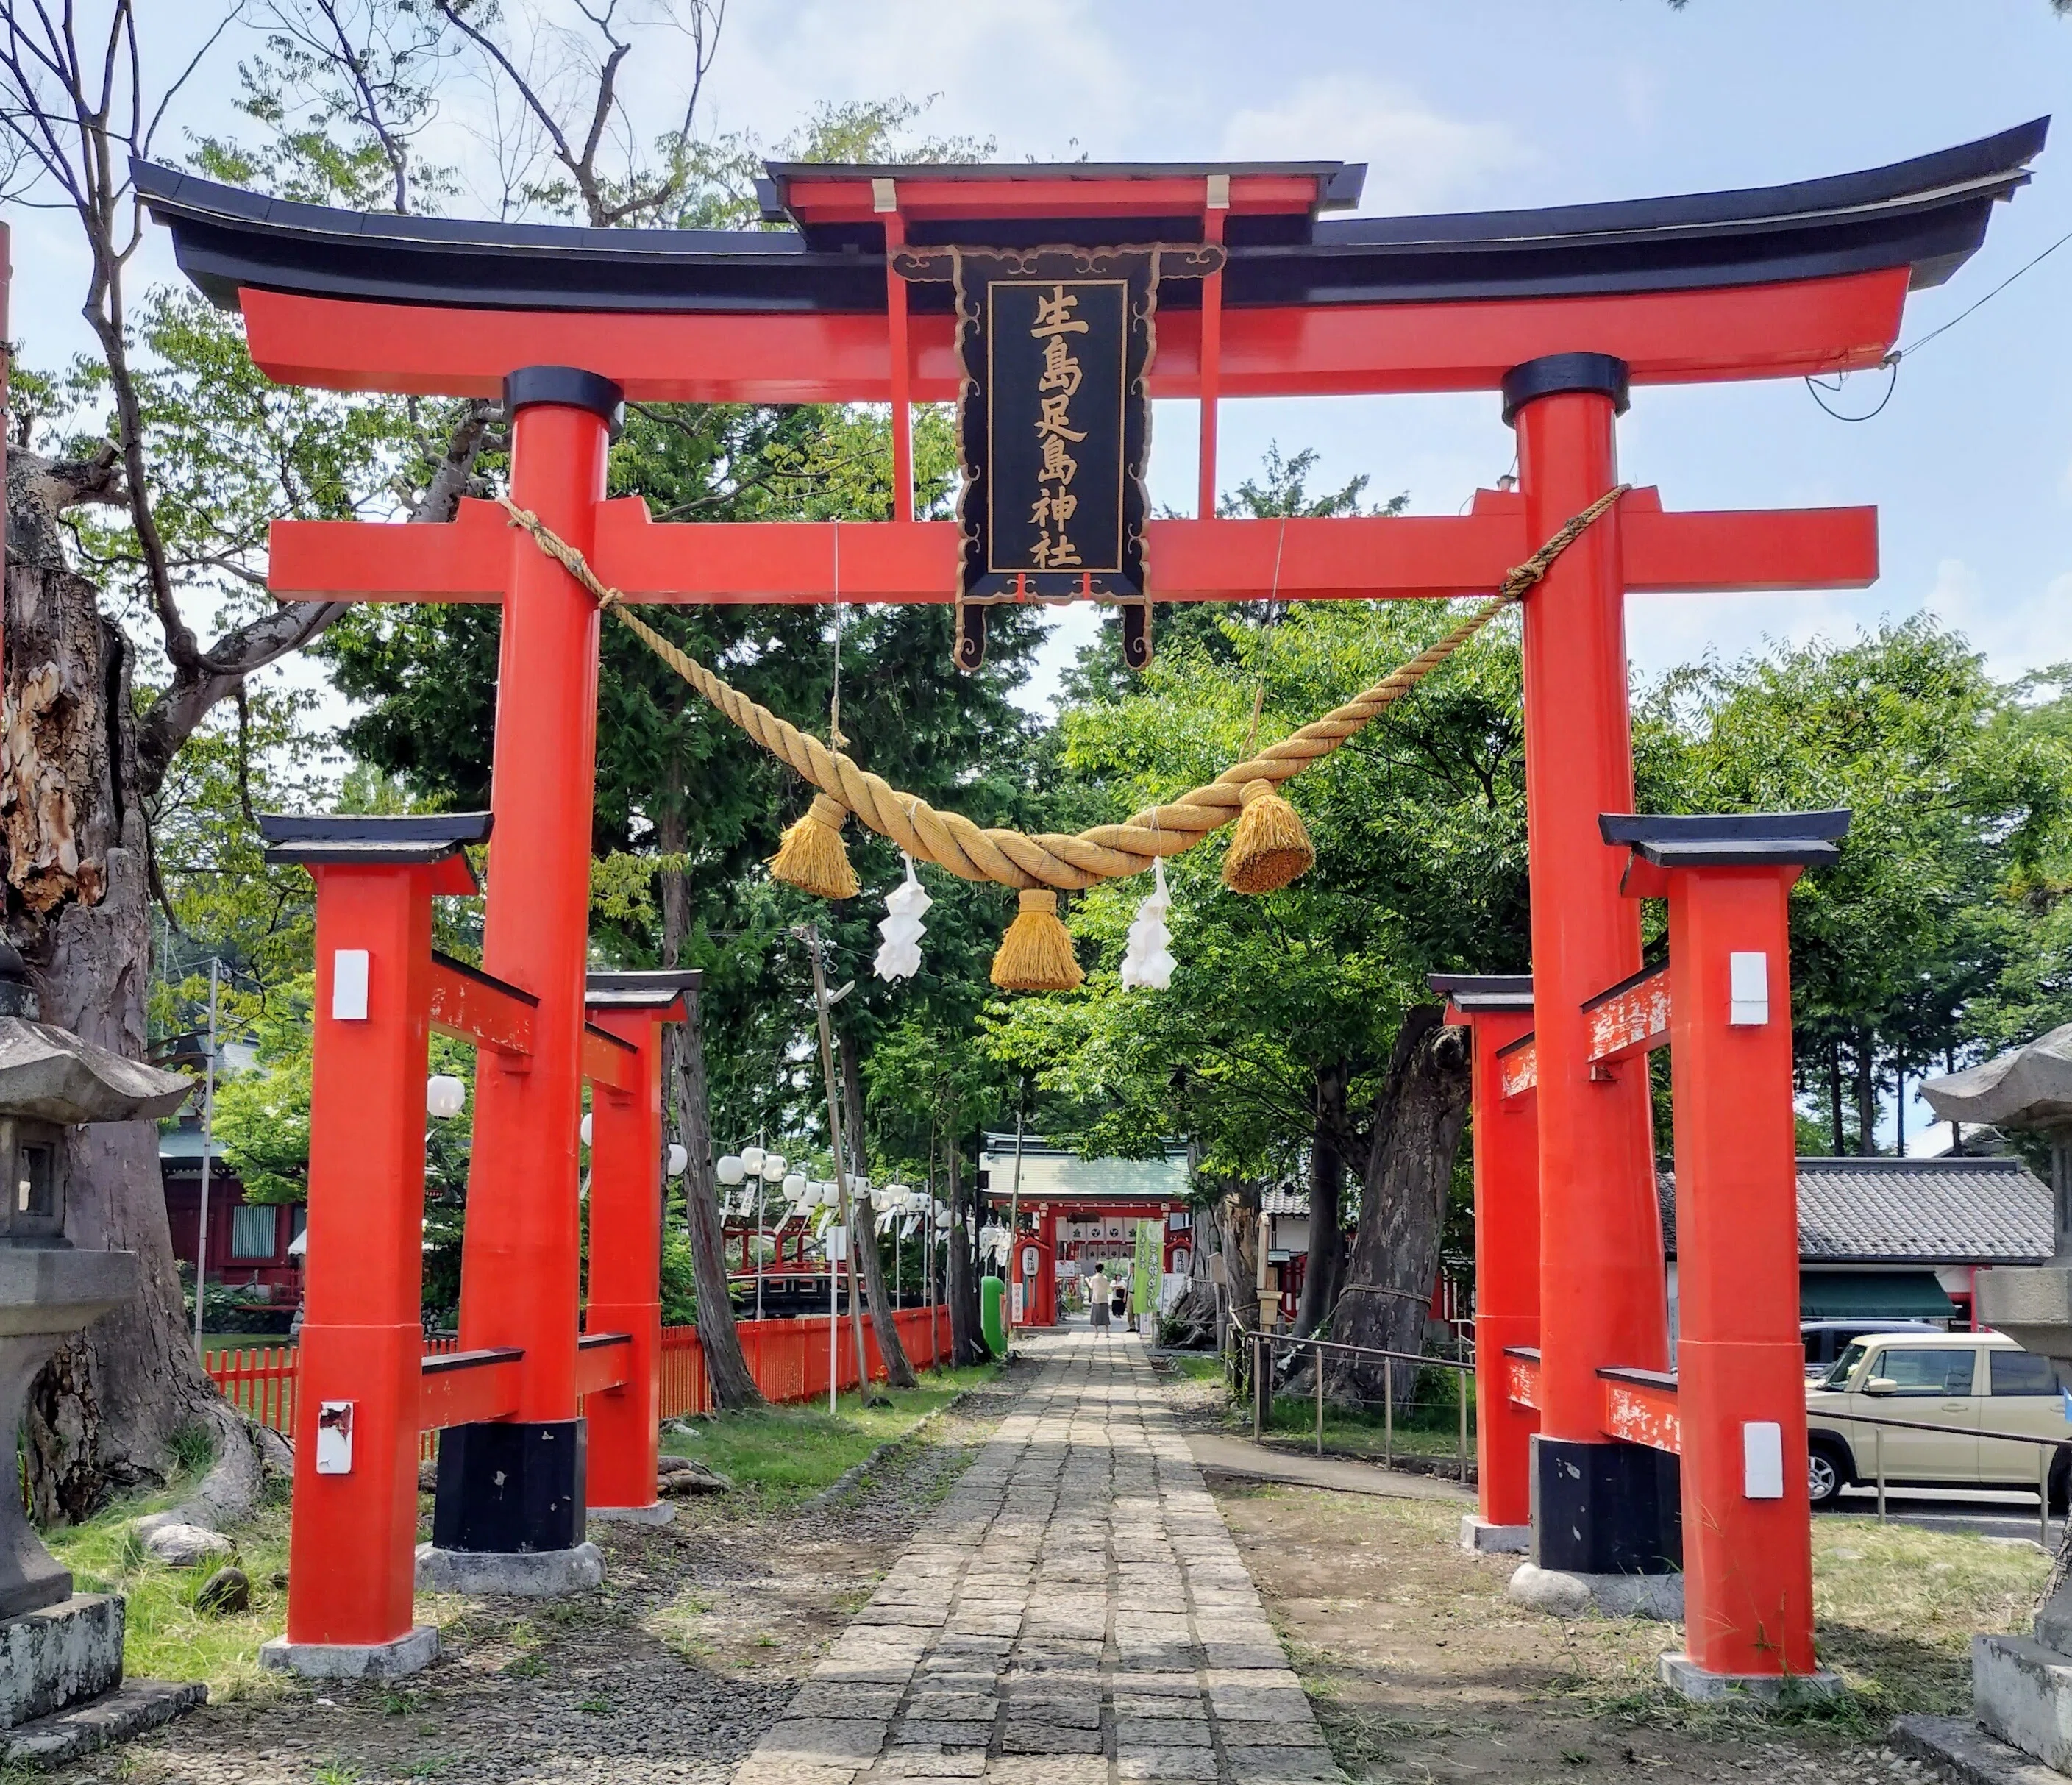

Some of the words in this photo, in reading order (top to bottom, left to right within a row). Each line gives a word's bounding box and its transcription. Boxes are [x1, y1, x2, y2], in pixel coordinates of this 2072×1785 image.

[1028, 285, 1089, 569] 生島足島神社
